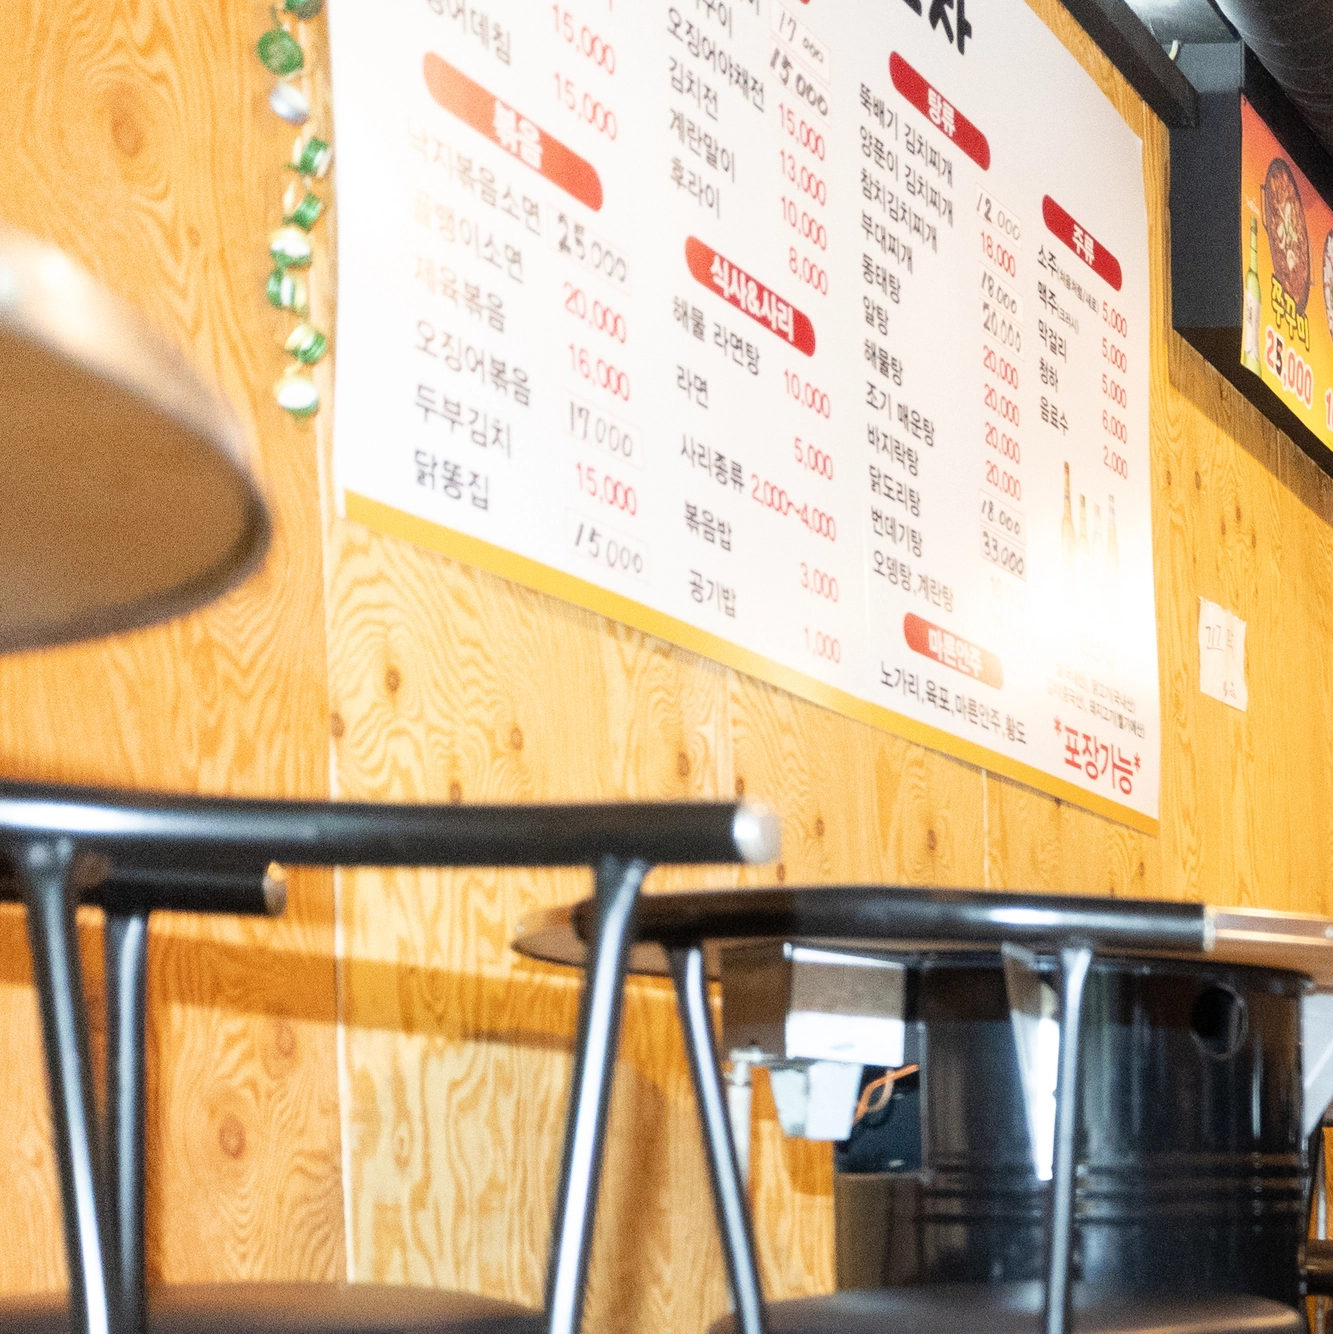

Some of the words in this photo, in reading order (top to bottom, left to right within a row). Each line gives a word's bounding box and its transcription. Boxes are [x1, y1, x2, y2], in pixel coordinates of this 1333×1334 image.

[552, 3, 616, 75] 15,000
[554, 72, 618, 140] 15,000
[667, 6, 765, 113] 오징어야채전
[779, 102, 826, 161] 15,000
[927, 87, 957, 137] 탕류
[668, 56, 718, 122] 김치전
[780, 149, 827, 206] 13,000
[859, 83, 898, 140] 뚝배기
[904, 123, 953, 188] 김치찌개
[669, 107, 736, 183] 계란말이
[781, 195, 828, 251] 10,000
[859, 126, 898, 181] 양푼이
[904, 163, 953, 228] 김치찌개
[981, 231, 1016, 278] 18,000
[860, 168, 937, 253] 참치김치찌개
[671, 156, 721, 220] 후라이
[789, 246, 829, 296] 8,000
[861, 210, 913, 275] 부대찌개
[1072, 223, 1095, 266] 주류
[563, 281, 628, 344] 20,000
[711, 251, 795, 343] 식사&사리
[862, 253, 901, 304] 동태탕
[983, 345, 1018, 390] 20,000
[1102, 301, 1127, 338] 5,000
[415, 319, 531, 407] 오징어볶음
[568, 343, 631, 402] 16,000
[783, 369, 831, 419] 10,000
[863, 296, 889, 336] 알탕
[984, 384, 1019, 427] 20,000
[1038, 318, 1067, 363] 막걸리
[1101, 374, 1127, 409] 5,000
[1102, 338, 1127, 373] 5,000
[1266, 328, 1313, 407] 25,000
[677, 364, 709, 410] 라면
[794, 436, 833, 480] 5,000
[864, 338, 902, 386] 해물탕
[985, 422, 1020, 465] 20,000
[866, 380, 891, 421] 조기
[897, 402, 934, 447] 매운탕
[986, 460, 1021, 501] 20,000
[1039, 357, 1058, 393] 청하
[1102, 410, 1127, 444] 6,000
[1041, 396, 1069, 436] 음료수
[1103, 446, 1128, 480] 2,000
[414, 450, 489, 512] 닭똥집
[415, 384, 512, 460] 두부김치
[575, 462, 638, 517] 15,000
[681, 433, 744, 494] 사리종류
[867, 422, 918, 477] 바지락탕
[869, 464, 920, 517] 닭도리탕
[685, 499, 732, 553] 볶음밥
[801, 561, 839, 602] 3,000
[870, 505, 922, 558] 번데기탕
[690, 569, 737, 620] 공기밥
[804, 626, 840, 663] 1,000
[928, 628, 984, 678] 마른안주
